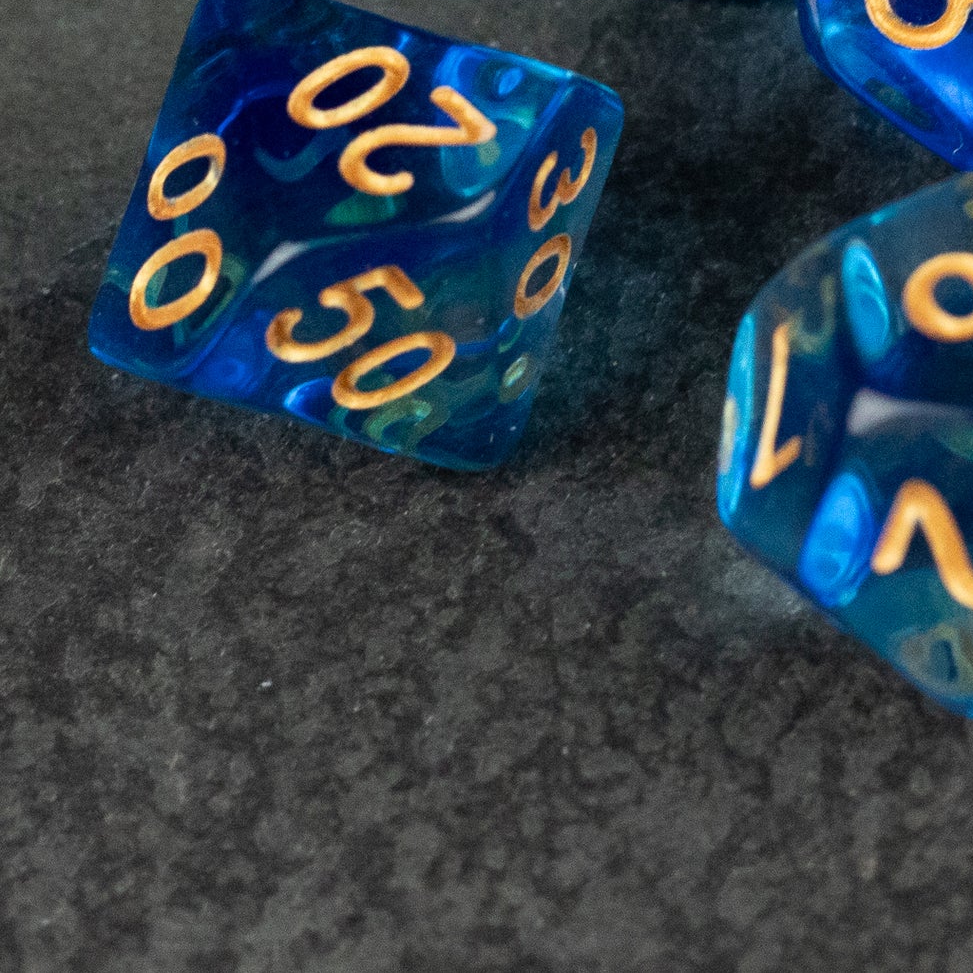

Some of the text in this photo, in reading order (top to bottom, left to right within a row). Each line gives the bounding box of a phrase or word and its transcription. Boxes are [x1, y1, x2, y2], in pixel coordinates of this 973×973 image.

[286, 45, 498, 197] 20
[128, 133, 228, 332] 00
[512, 127, 599, 321] 30
[265, 265, 458, 412] 50
